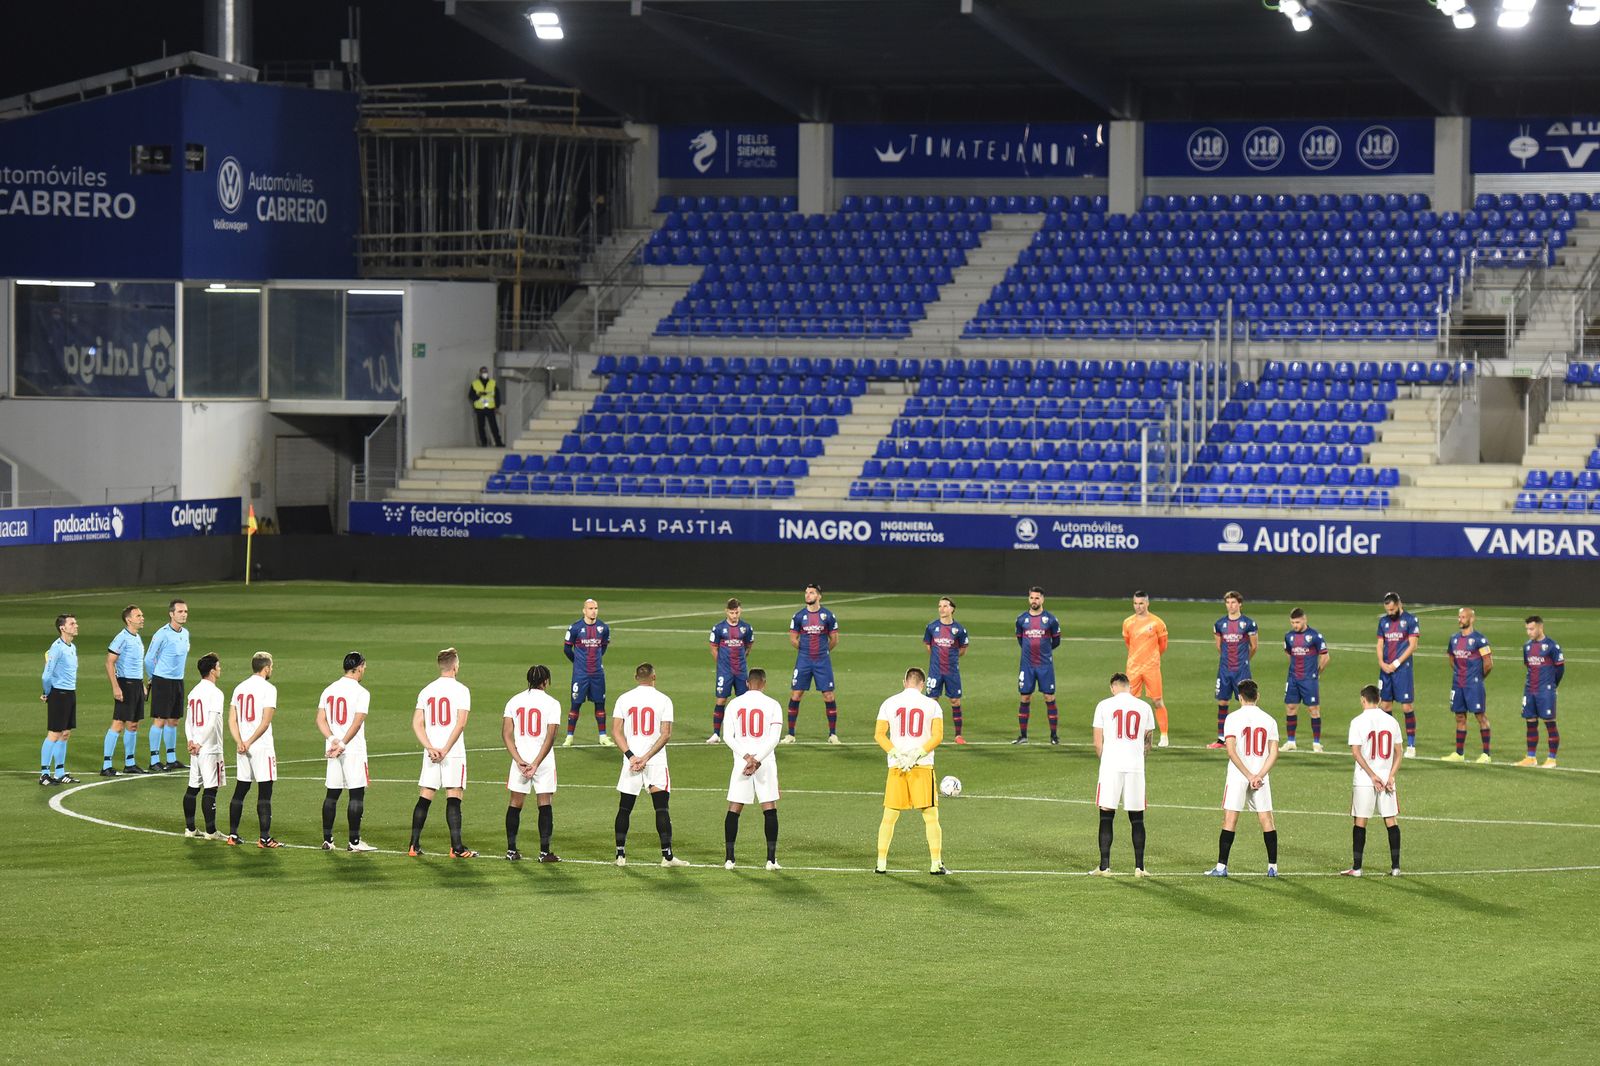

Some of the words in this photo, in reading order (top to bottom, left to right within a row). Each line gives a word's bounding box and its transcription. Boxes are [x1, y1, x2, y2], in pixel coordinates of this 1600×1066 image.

[737, 134, 769, 145] FIELES
[1192, 136, 1223, 156] J10
[1249, 135, 1280, 155] J10
[1305, 135, 1336, 155] J10
[1362, 134, 1394, 154] J10
[737, 146, 776, 157] SIEMPRE
[737, 157, 777, 169] FanClub
[0, 165, 107, 187] tomóviles
[248, 171, 314, 193] Automóviles
[256, 196, 328, 224] CABRERO
[53, 512, 111, 542] podoactiva
[171, 503, 218, 530] Colnatur
[410, 505, 513, 527] federópticos
[572, 518, 647, 533] LILLAS
[657, 519, 733, 535] PASTIA
[1052, 520, 1124, 533] Automóviles
[411, 525, 439, 537] Pérez
[440, 526, 469, 538] Bolea
[778, 517, 872, 541] iNAGRO
[880, 532, 888, 542] Y
[889, 532, 945, 543] PROYECTOS
[1253, 524, 1382, 555] Autolíder
[1060, 533, 1140, 550] CABRERO
[1488, 527, 1600, 556] AMBAR
[572, 682, 579, 693] 6
[717, 676, 724, 687] 3
[189, 698, 204, 726] 10
[237, 693, 255, 722] 10
[326, 695, 347, 725] 10
[427, 696, 451, 726] 10
[516, 707, 542, 736] 10
[628, 706, 655, 736] 10
[737, 708, 764, 737] 10
[895, 707, 924, 737] 10
[1112, 709, 1140, 739] 10
[1242, 726, 1267, 757] 10
[1367, 730, 1392, 760] 10
